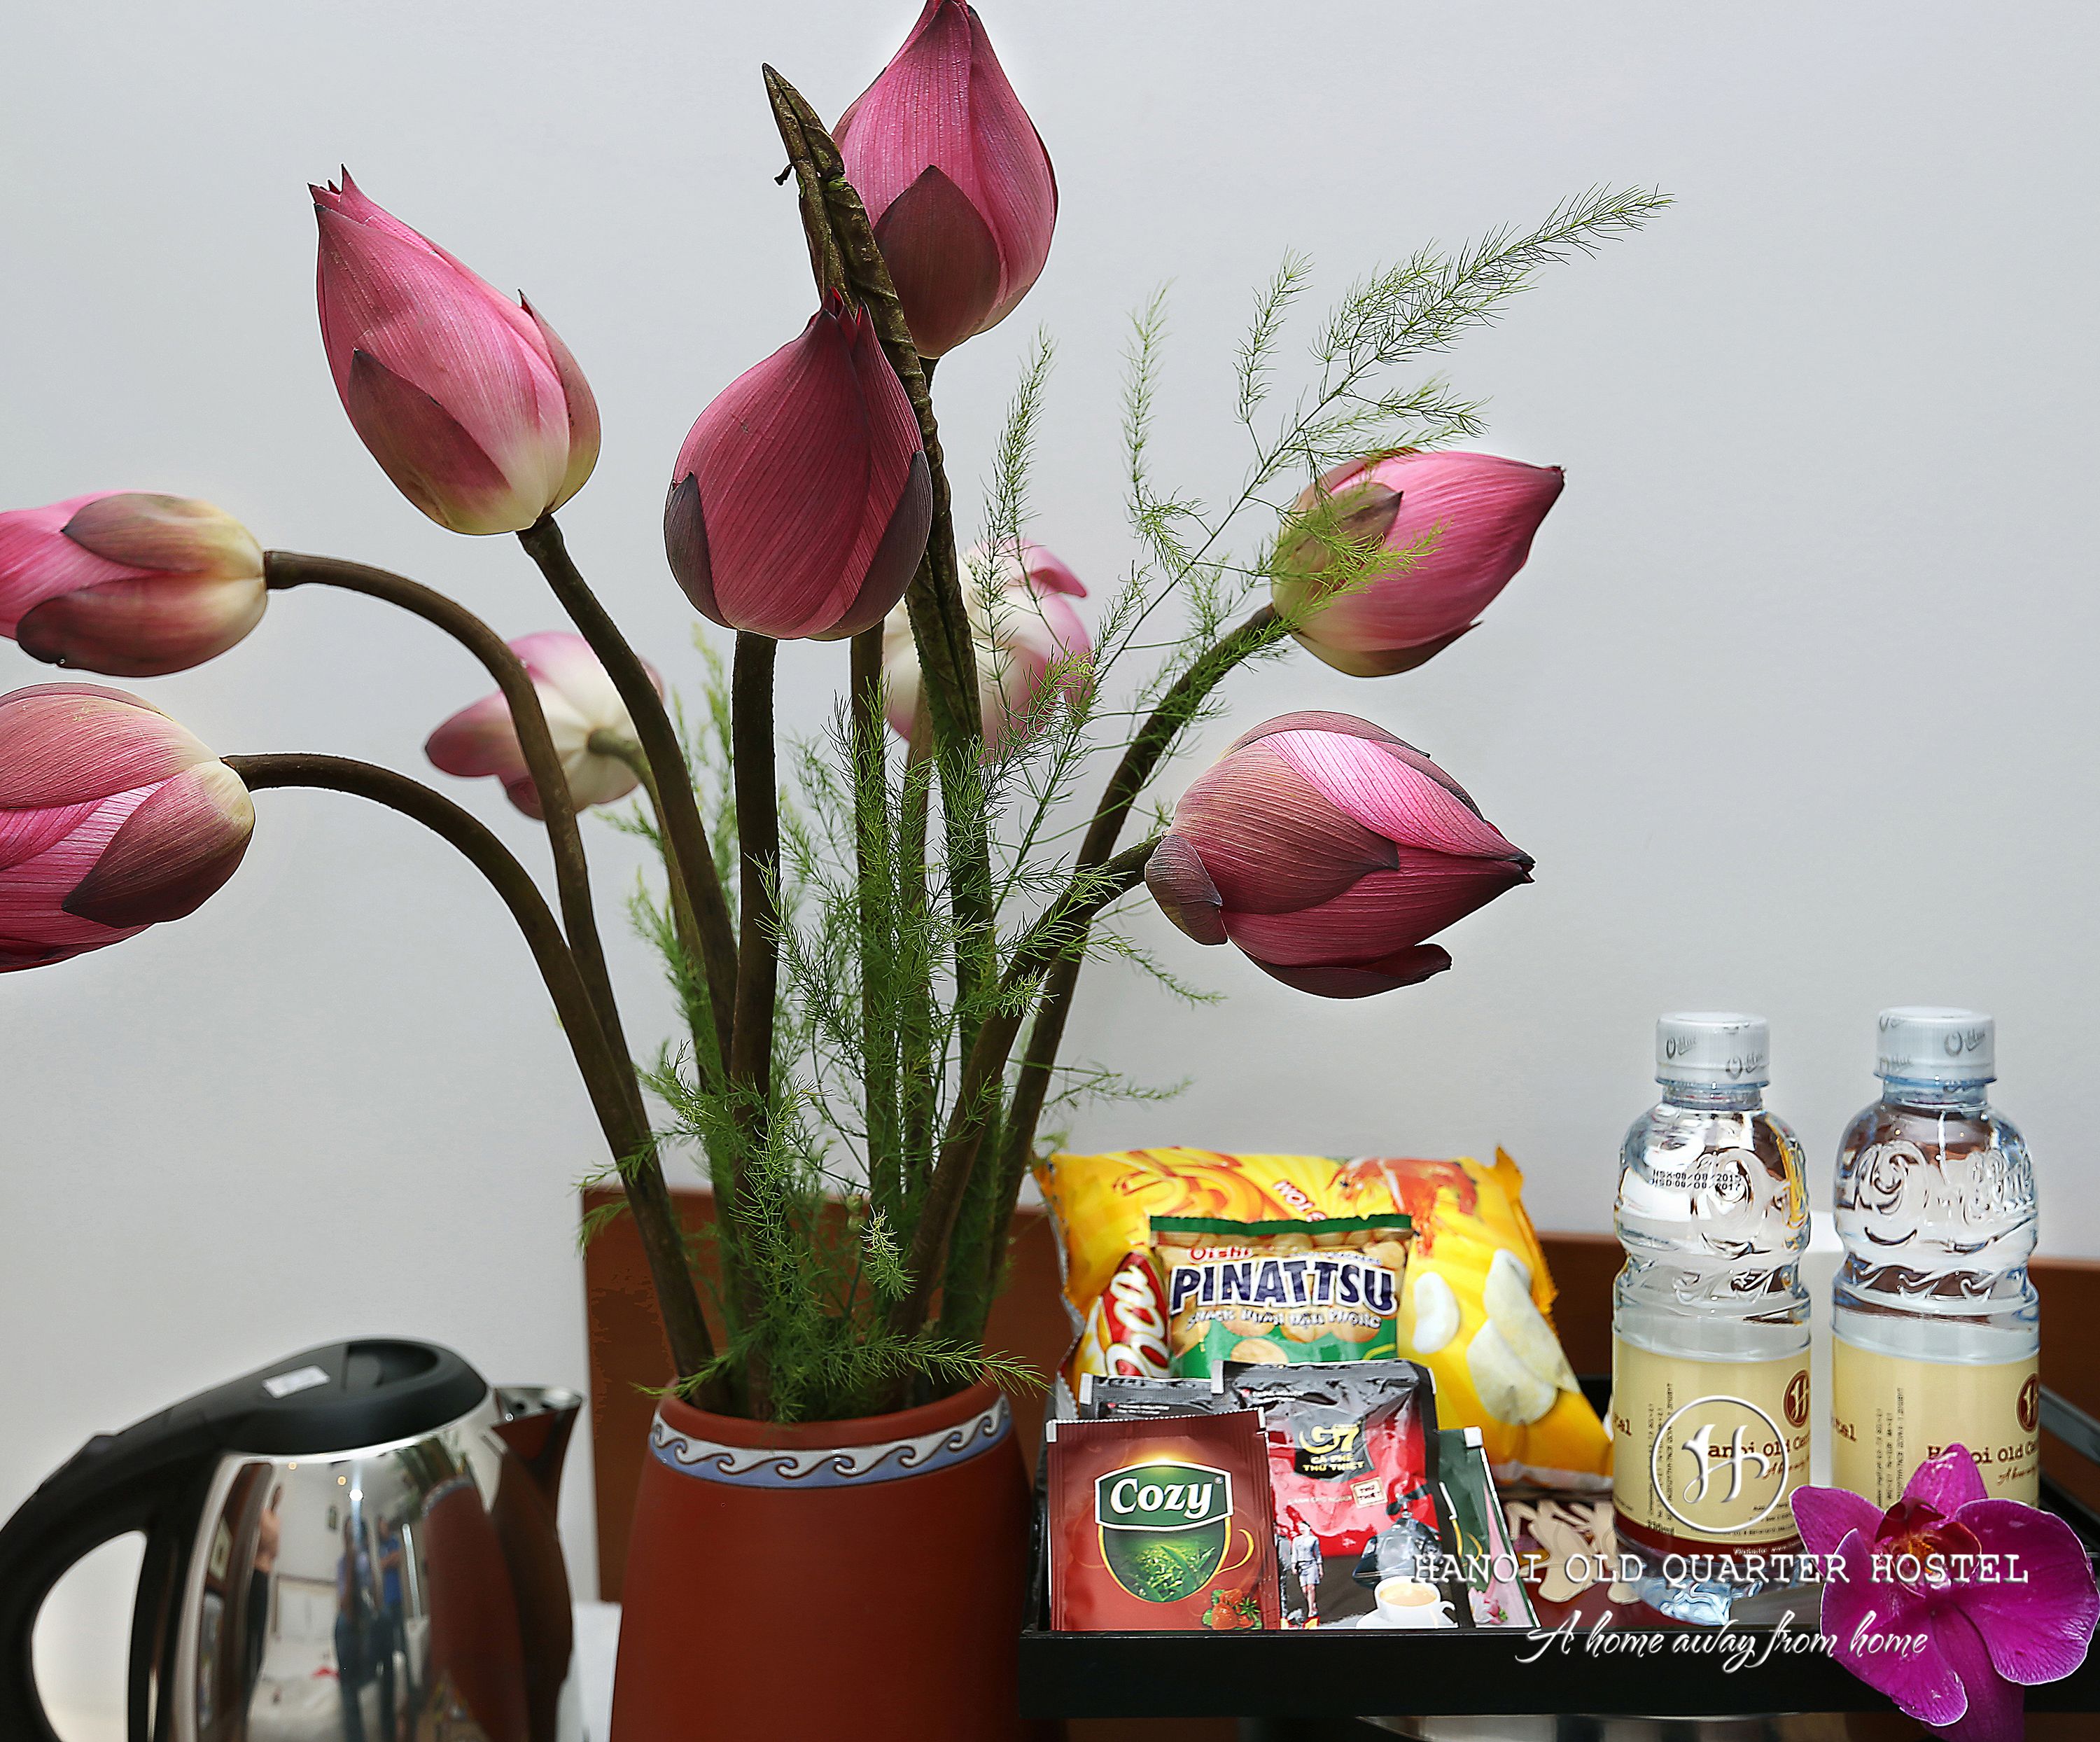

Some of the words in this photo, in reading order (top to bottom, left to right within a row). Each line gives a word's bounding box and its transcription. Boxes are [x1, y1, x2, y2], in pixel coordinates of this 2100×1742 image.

[1171, 1260, 1396, 1314] PINATTSU
[1298, 1422, 1360, 1454] G7
[1110, 1477, 1212, 1519] Cozy
